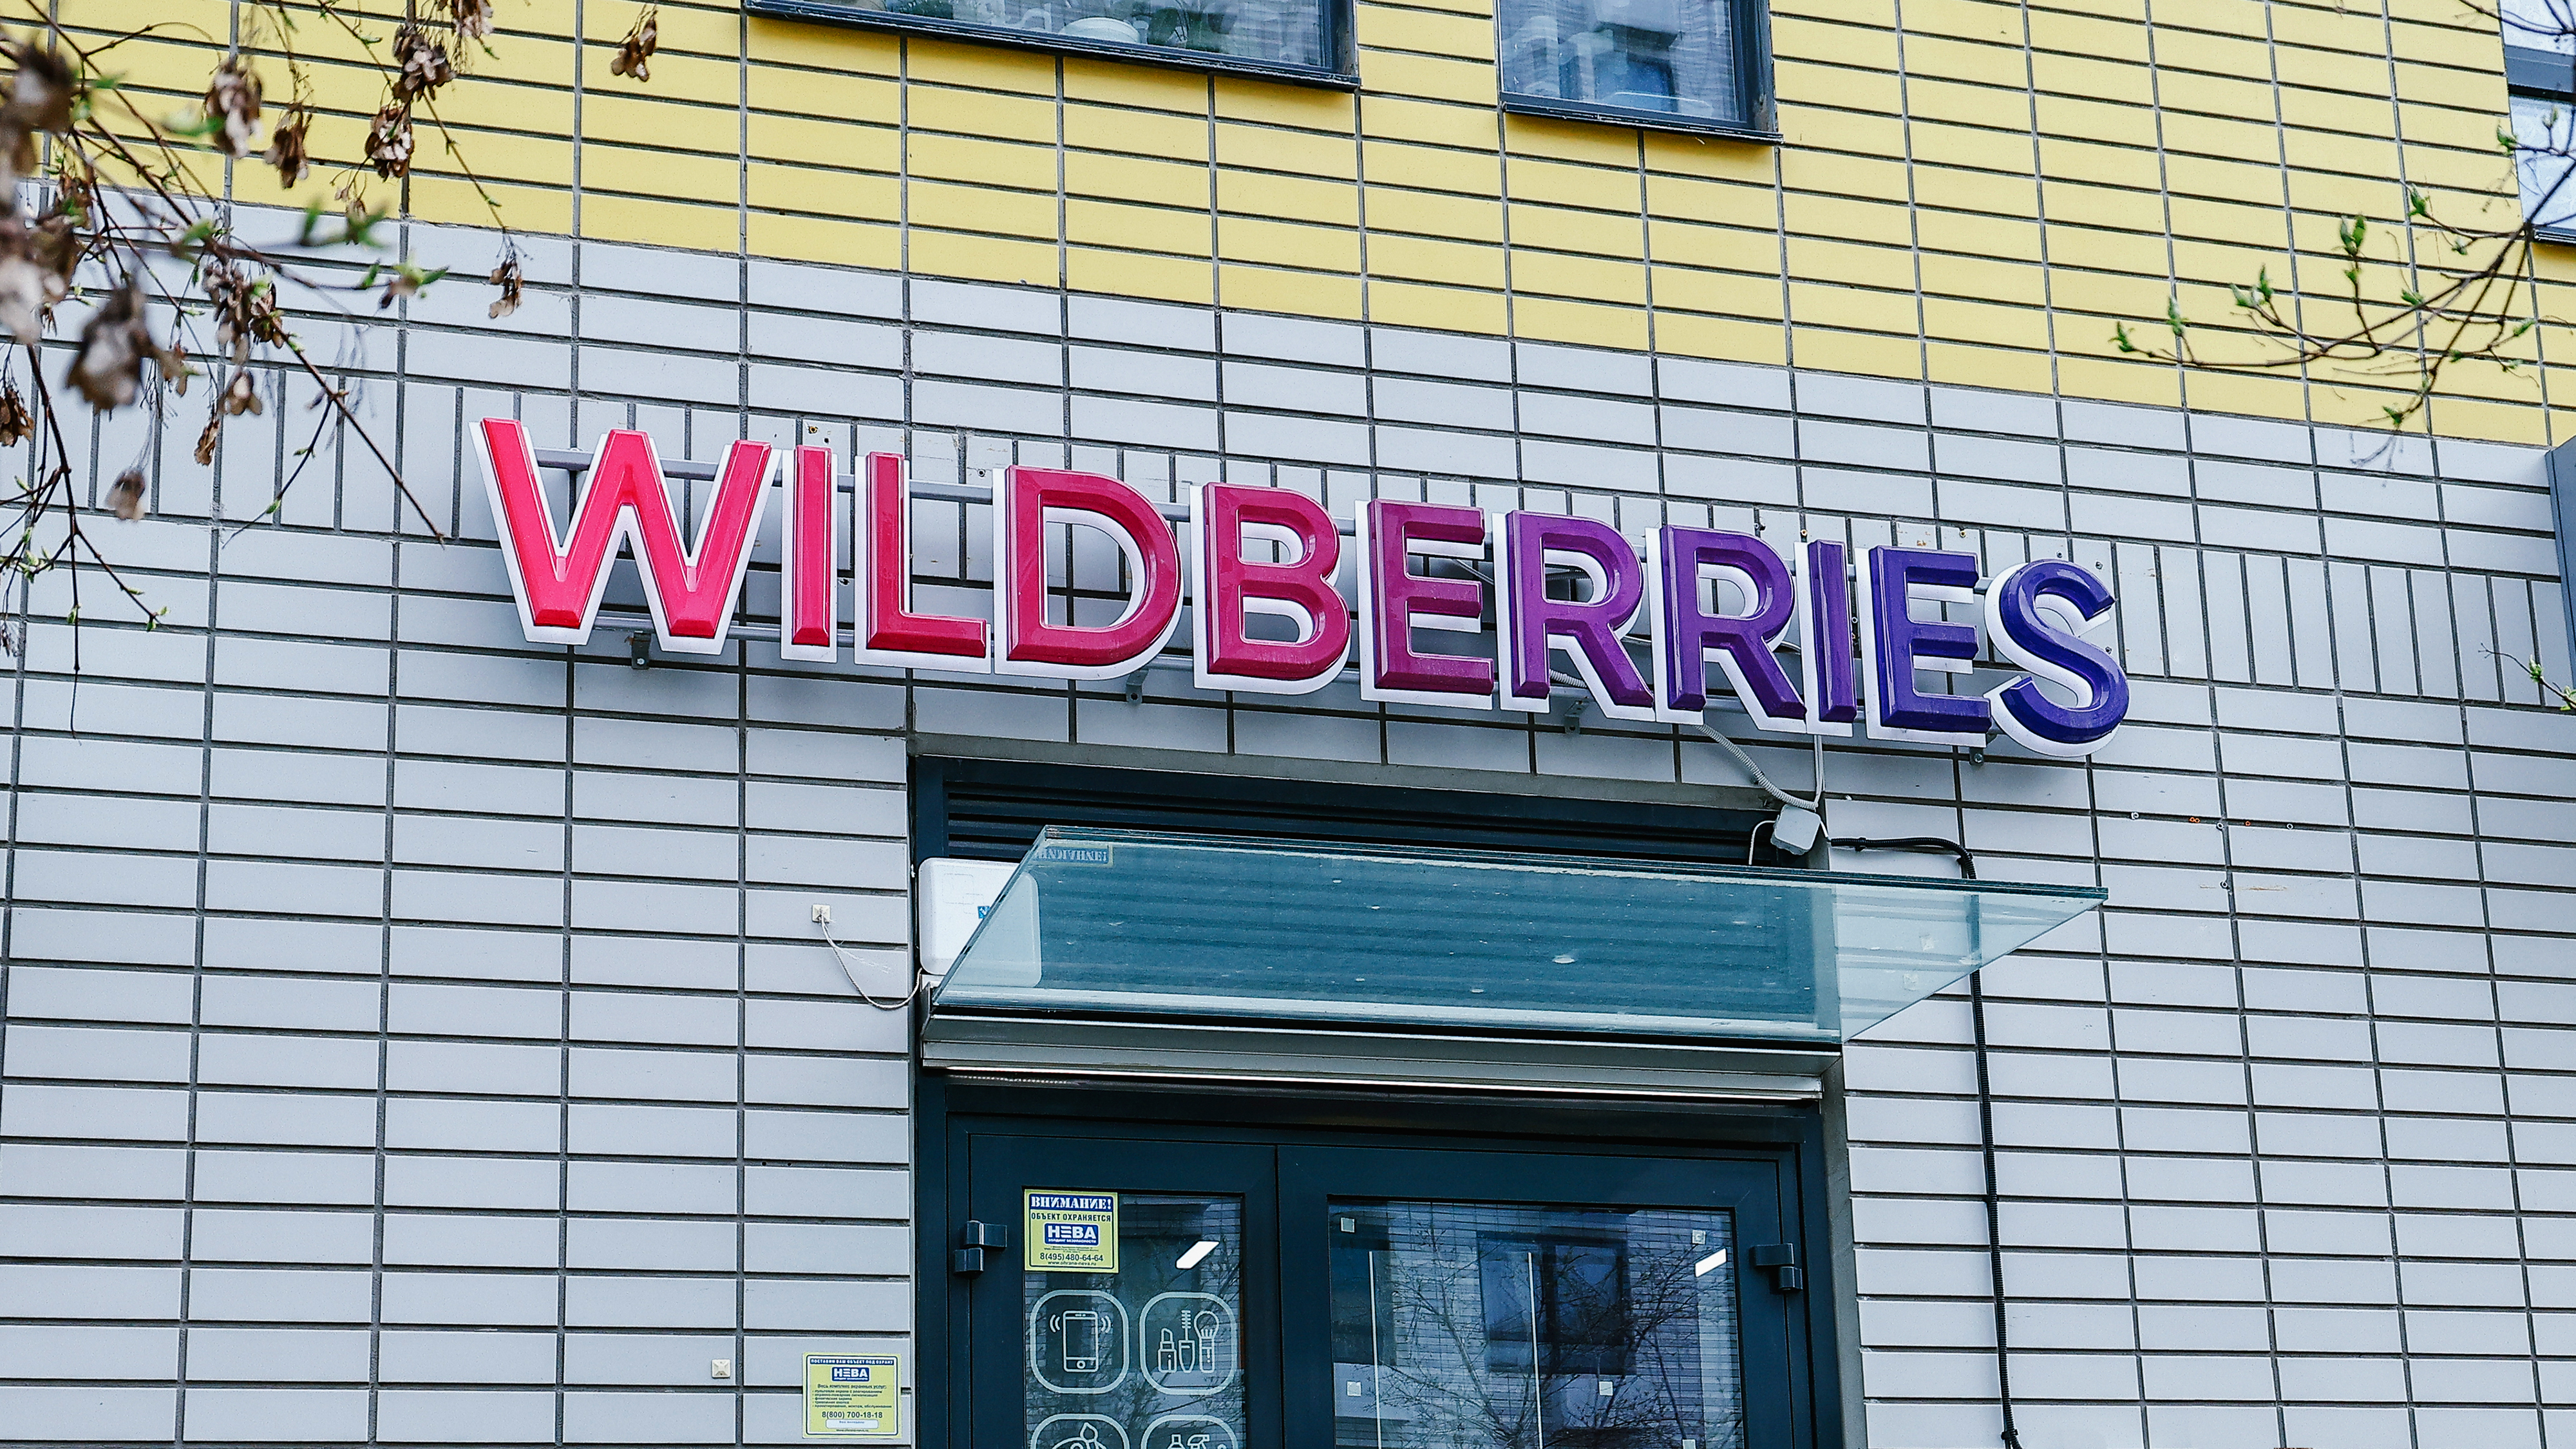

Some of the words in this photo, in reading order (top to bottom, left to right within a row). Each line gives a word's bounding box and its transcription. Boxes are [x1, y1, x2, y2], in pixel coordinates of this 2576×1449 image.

[470, 417, 2129, 757] WILDBERRIES
[1031, 1196, 1112, 1210] ВНИМАНИЕ!
[1031, 1212, 1061, 1220] ОБЪЕКТ
[1063, 1213, 1111, 1222] ОХРАНЯЕТСЯ
[1048, 1225, 1097, 1239] НЕВА
[1065, 1253, 1103, 1262] 480-64-64
[834, 1368, 868, 1378] НЕВА
